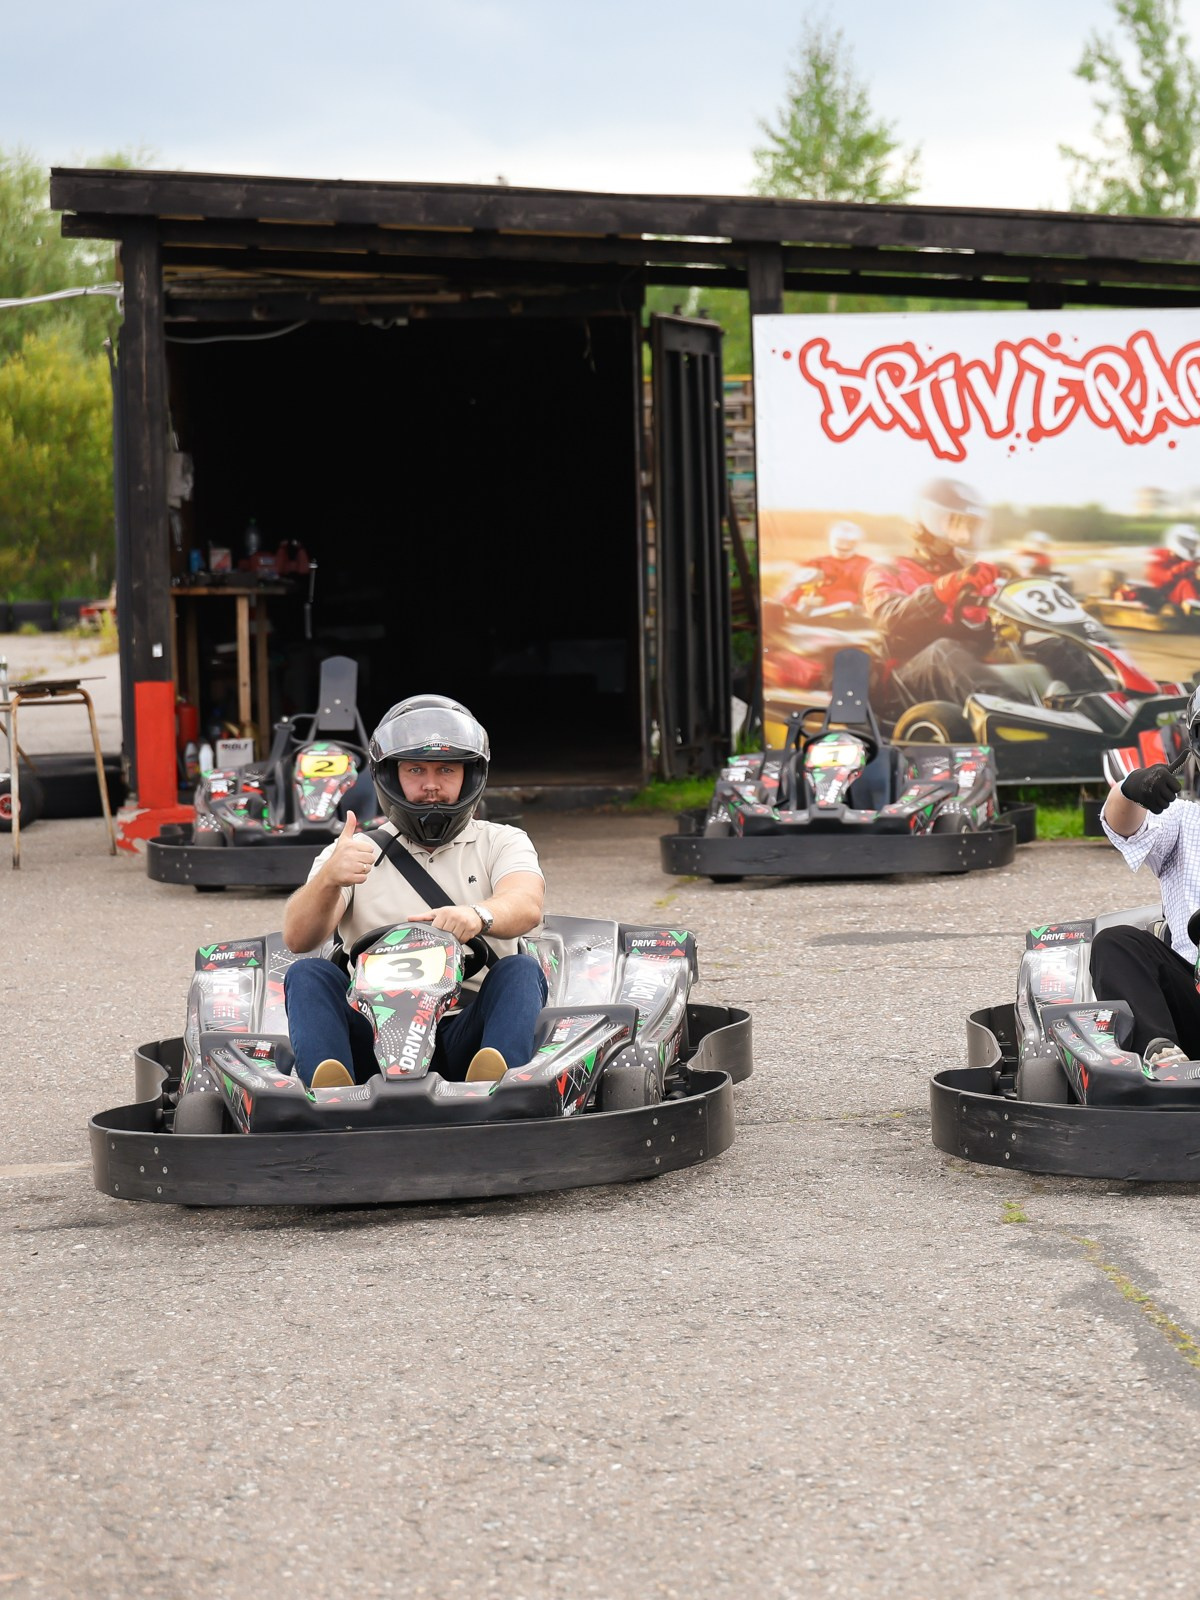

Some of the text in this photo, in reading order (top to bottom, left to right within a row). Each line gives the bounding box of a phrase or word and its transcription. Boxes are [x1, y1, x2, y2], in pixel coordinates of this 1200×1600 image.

[1027, 588, 1076, 615] 36
[314, 760, 335, 773] 2
[632, 939, 677, 947] DRIVEPARK
[1041, 931, 1085, 942] DRIVEPARK
[375, 940, 436, 954] DRIVEPARK
[209, 950, 256, 961] DRIVEPARK
[384, 958, 425, 982] 3
